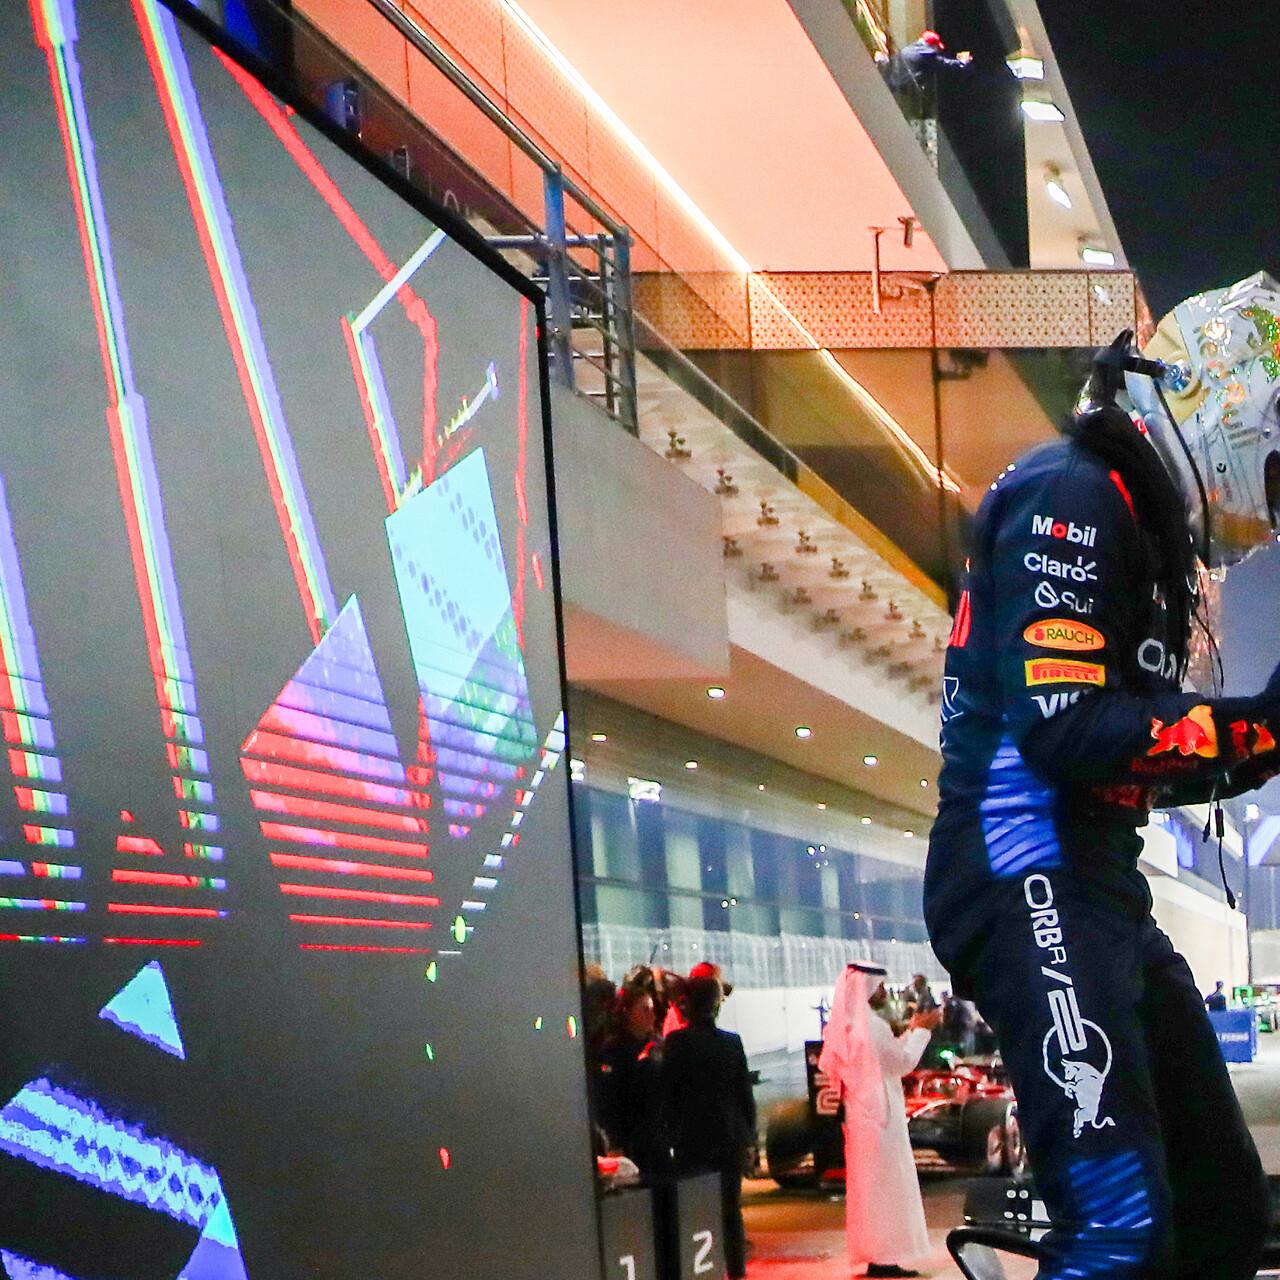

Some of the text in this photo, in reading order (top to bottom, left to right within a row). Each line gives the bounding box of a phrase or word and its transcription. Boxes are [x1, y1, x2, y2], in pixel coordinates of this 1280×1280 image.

[1032, 514, 1097, 547] Mobil
[1023, 552, 1092, 582] Claro
[1061, 591, 1094, 614] Sui
[1046, 628, 1095, 645] RAUCH
[693, 1230, 713, 1275] 2
